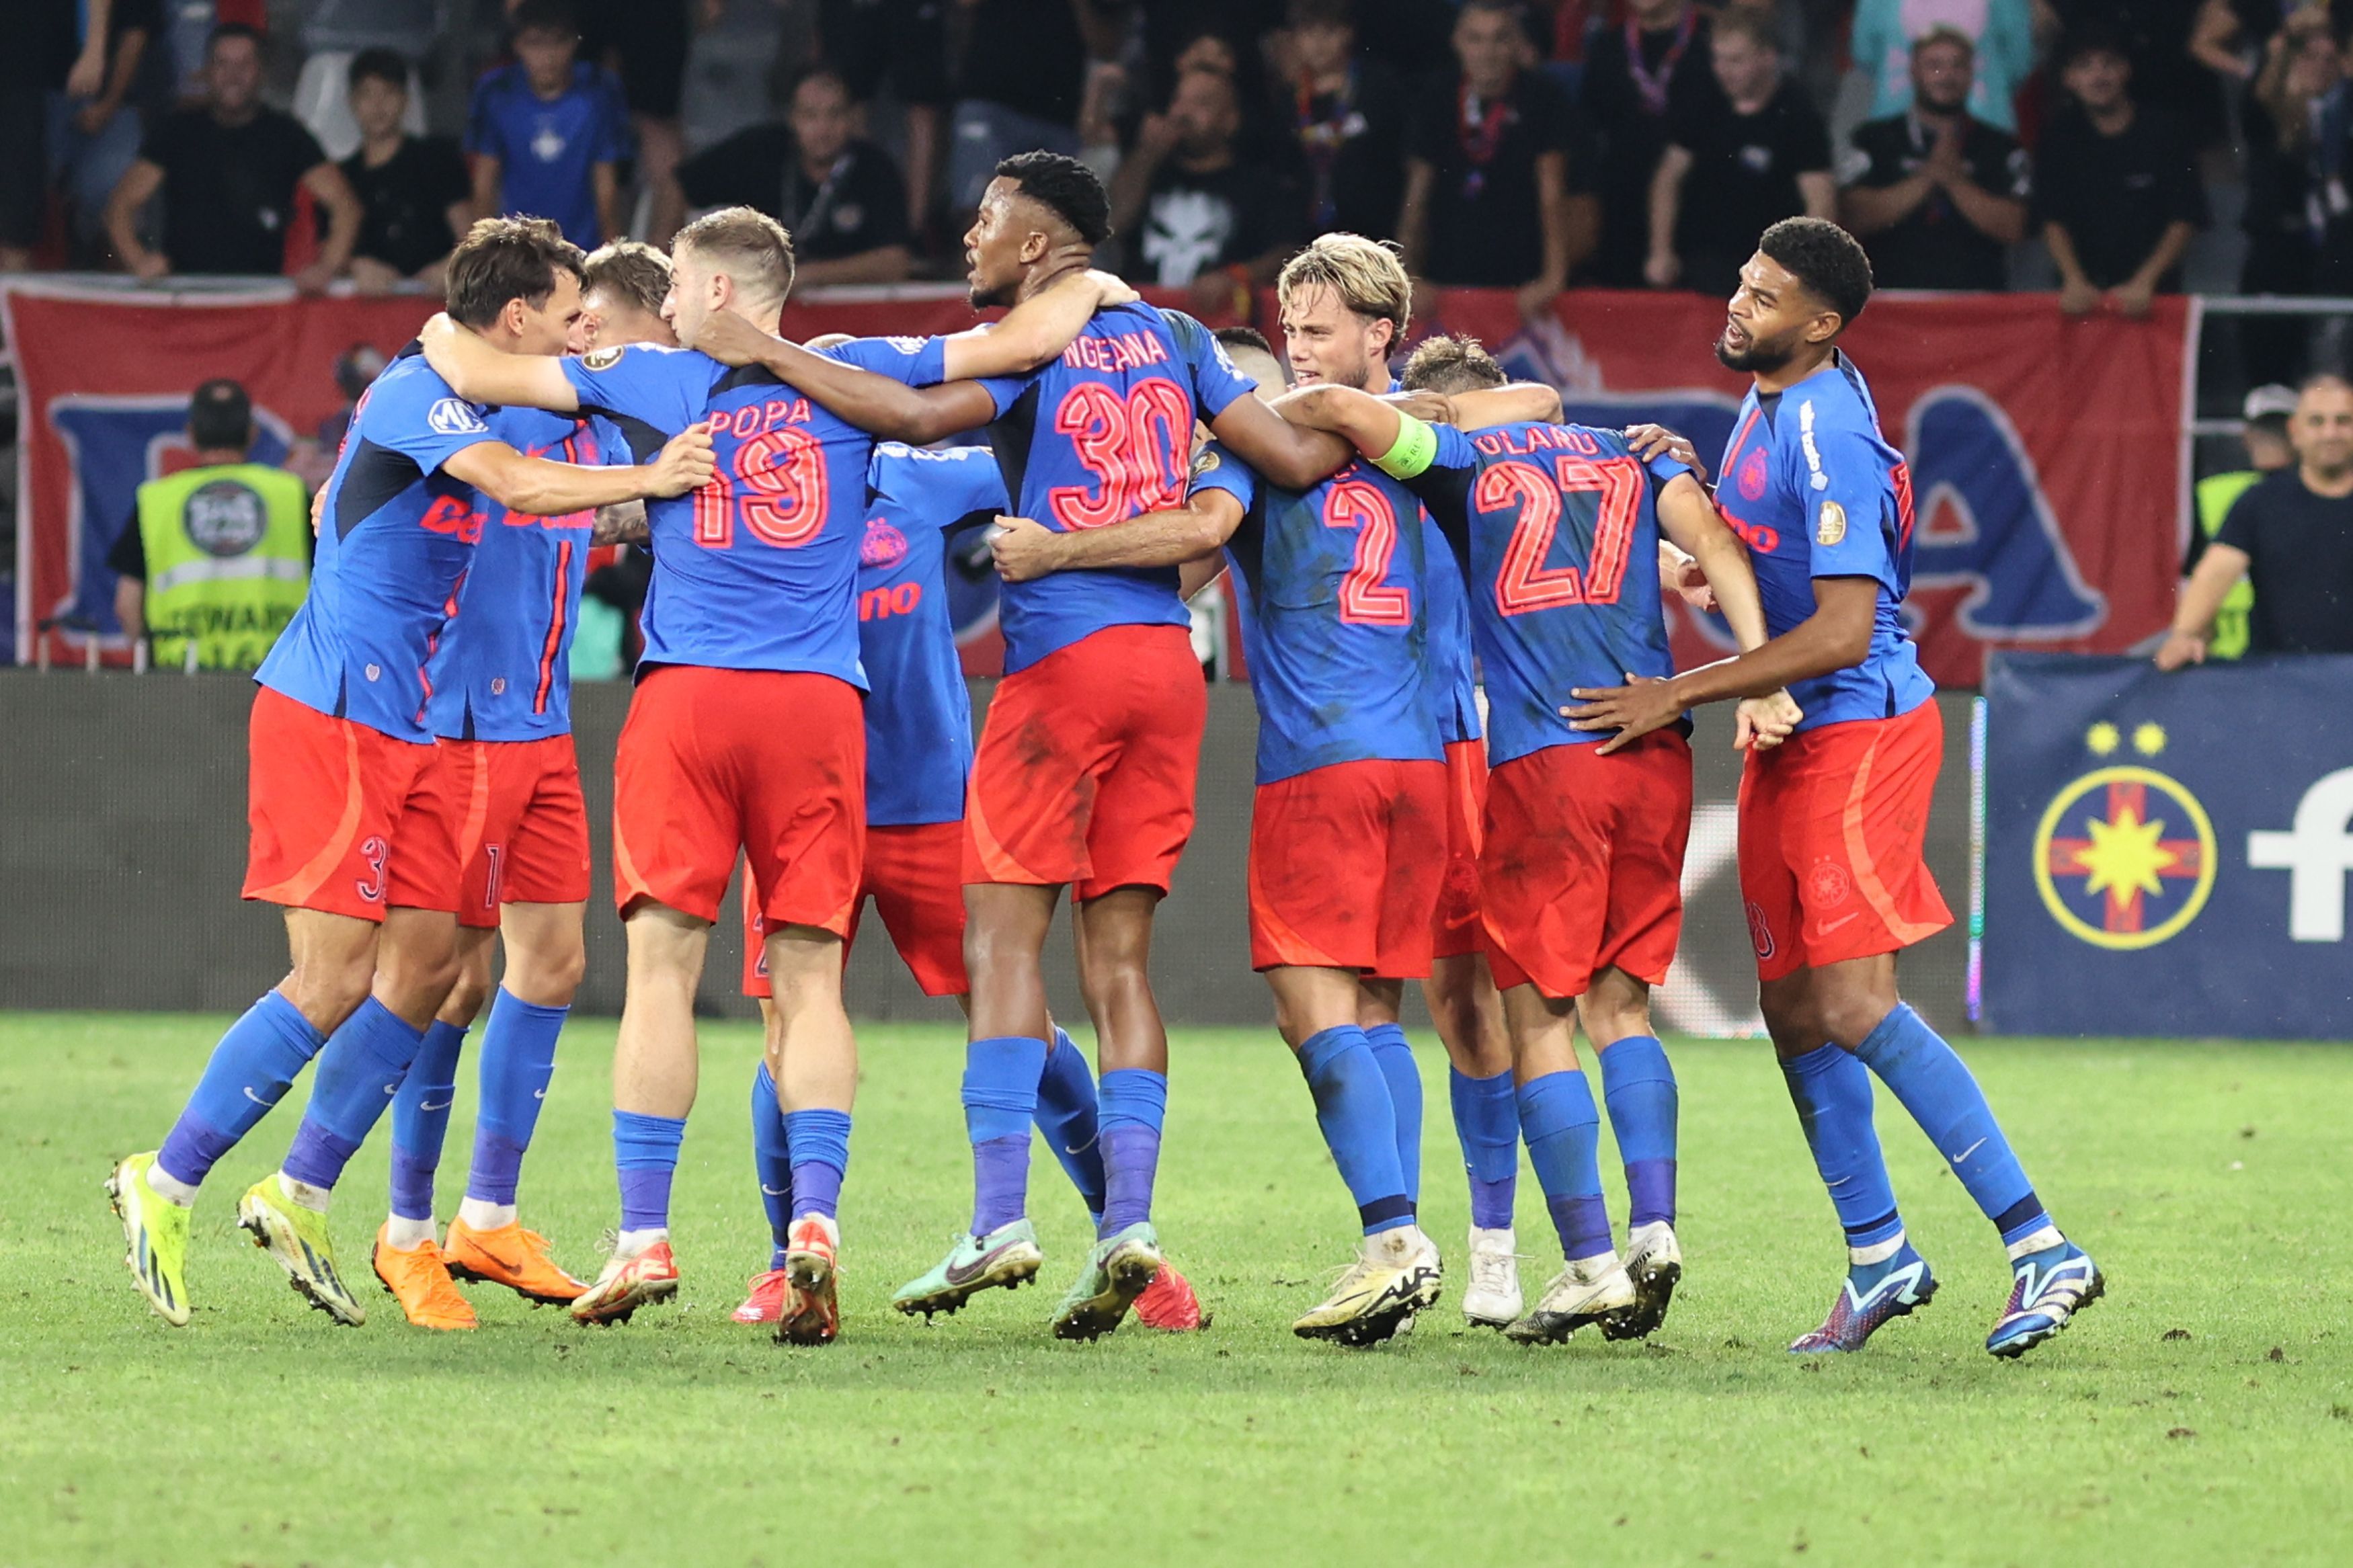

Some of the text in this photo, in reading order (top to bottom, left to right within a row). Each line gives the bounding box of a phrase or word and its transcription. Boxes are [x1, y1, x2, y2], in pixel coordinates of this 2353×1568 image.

[1063, 328, 1170, 374] NGEANA
[708, 397, 812, 439] POPA
[1049, 377, 1193, 532] 30
[1474, 425, 1600, 456] OLARU
[693, 426, 830, 549] 19
[1475, 455, 1645, 617] 27
[1323, 480, 1412, 626] 2
